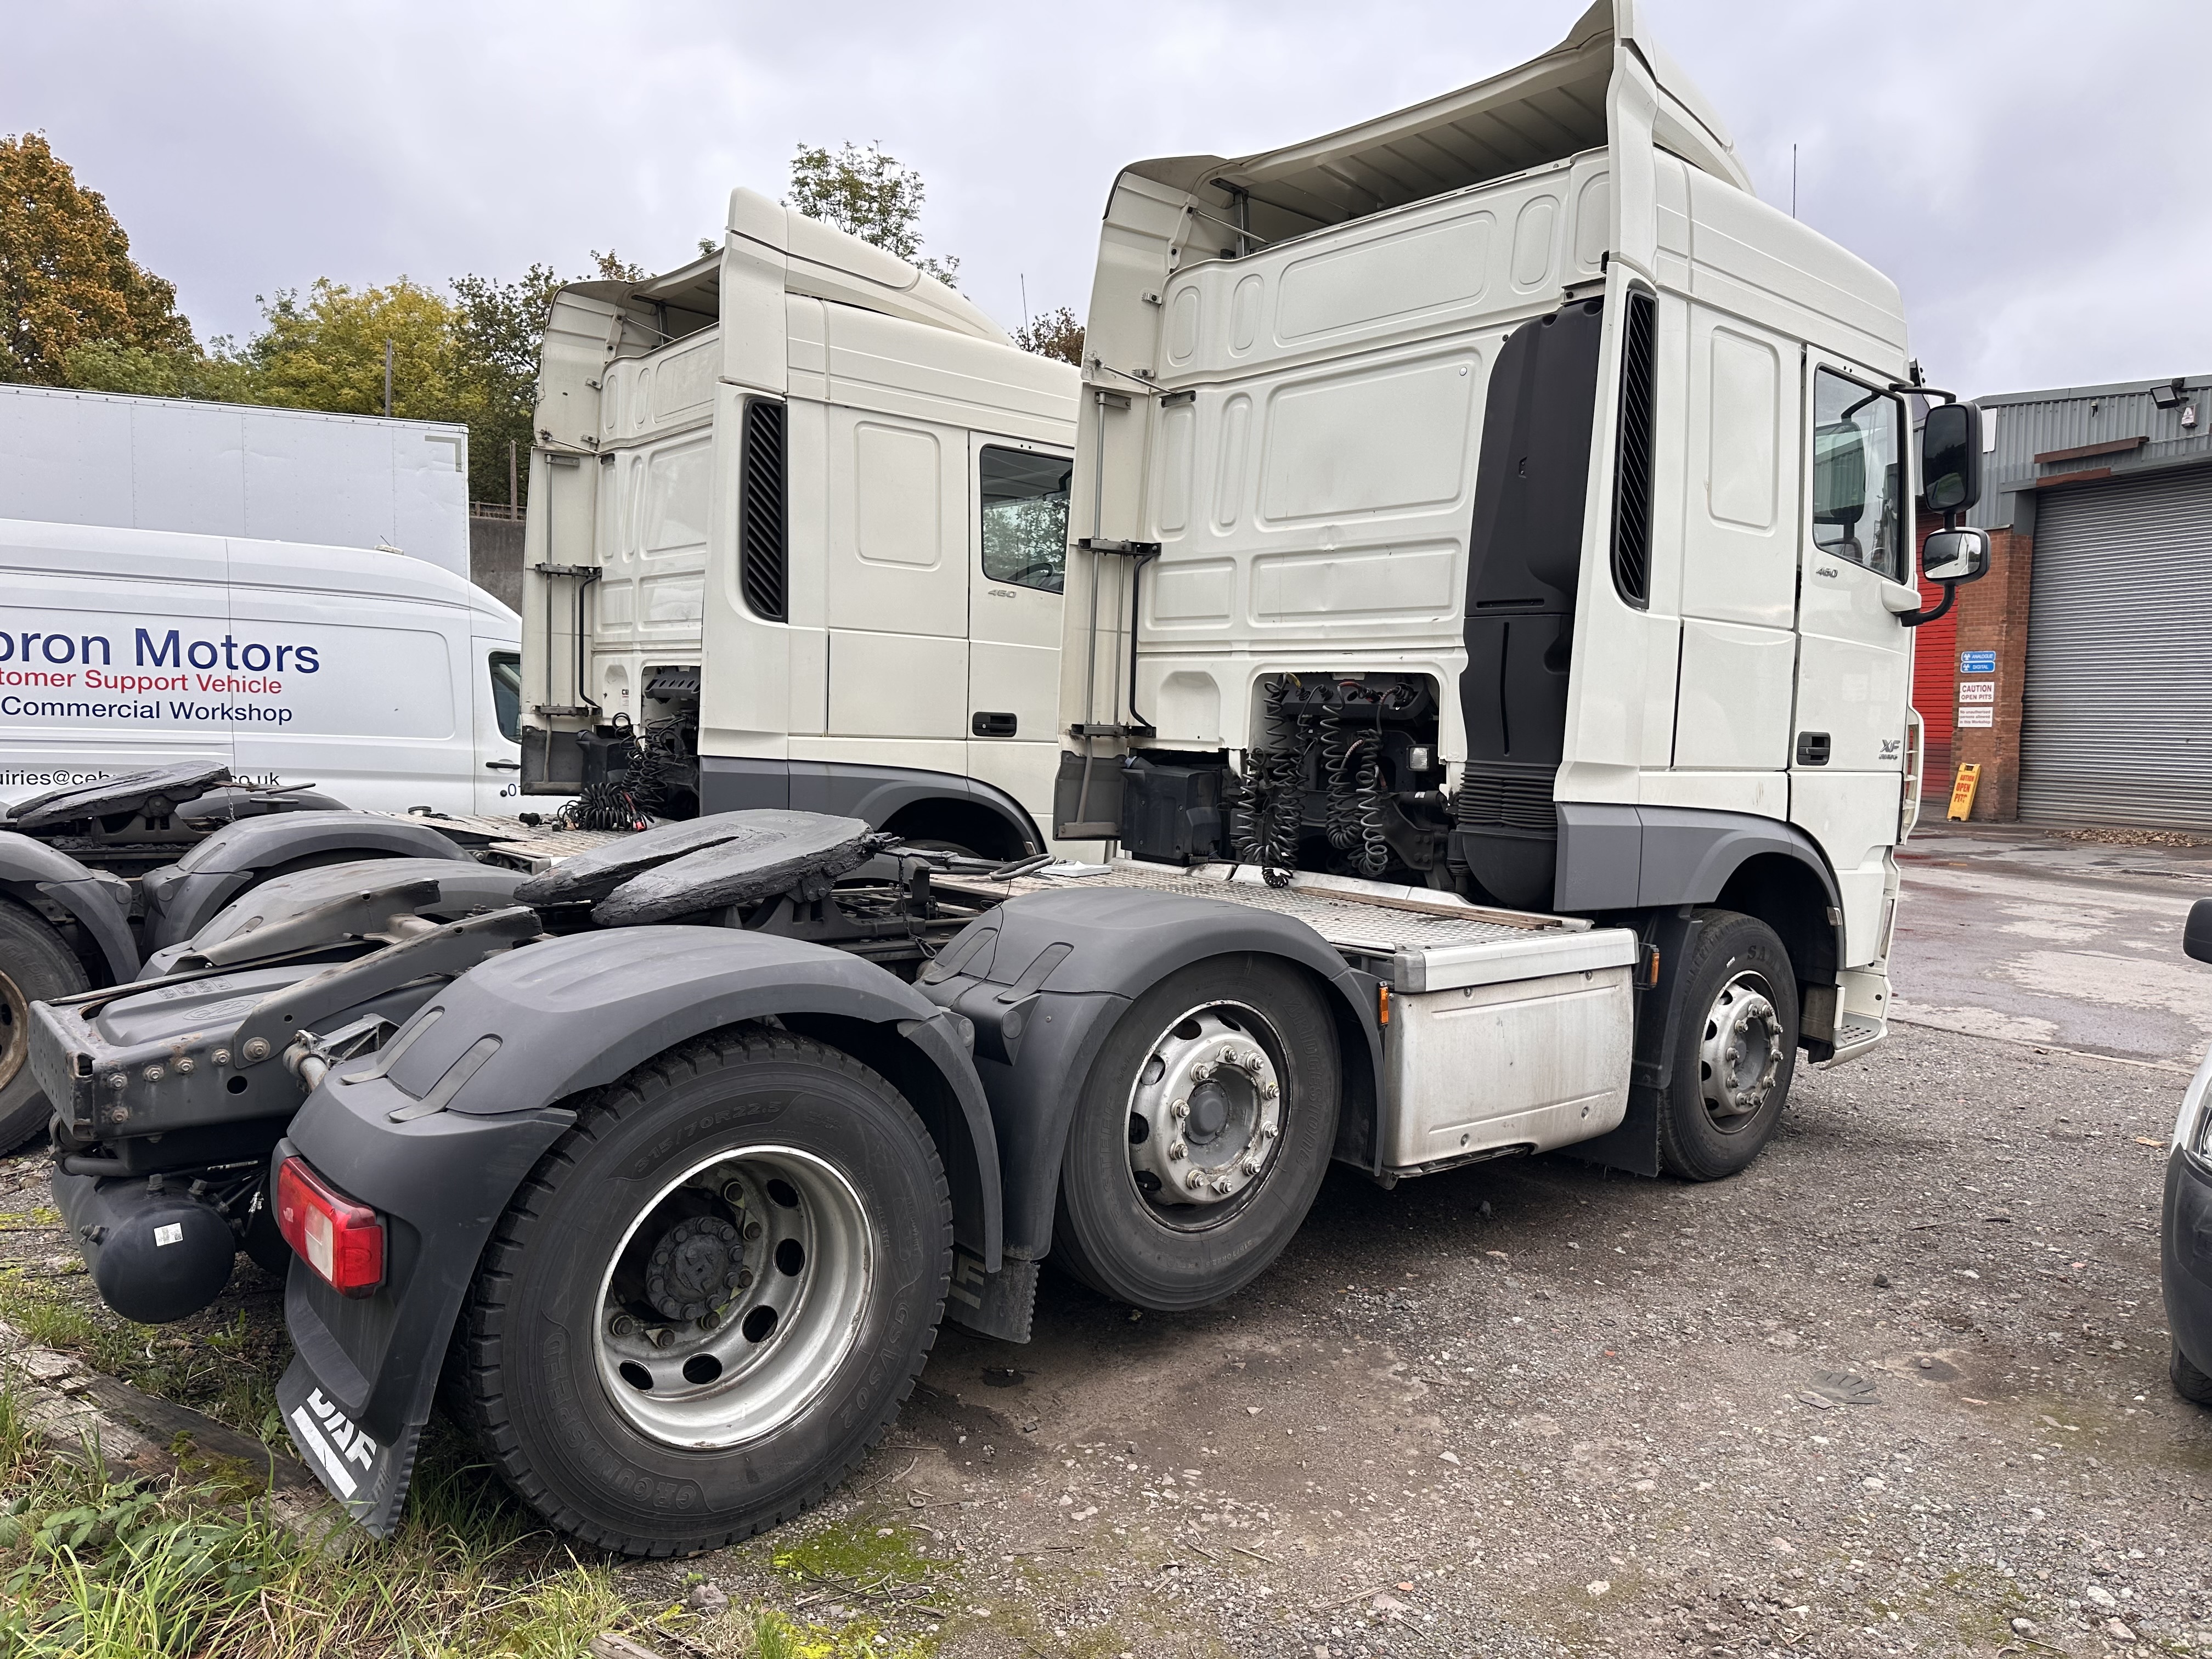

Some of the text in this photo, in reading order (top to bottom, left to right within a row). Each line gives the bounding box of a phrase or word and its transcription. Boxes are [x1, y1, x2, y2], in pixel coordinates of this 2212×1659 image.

[1816, 567, 1838, 578] 460
[988, 589, 1016, 598] 460
[135, 628, 319, 673] Motors
[85, 669, 189, 694] Support
[196, 674, 283, 694] Vehicle
[1, 696, 292, 725] Commercial Workshop
[1880, 739, 1900, 752] XF
[1956, 782, 1971, 792] OPEN
[1283, 996, 1323, 1169] BRIDGESTONE
[634, 1101, 782, 1173] 315/70R22.5
[543, 1331, 698, 1510] GROUNDSPEED
